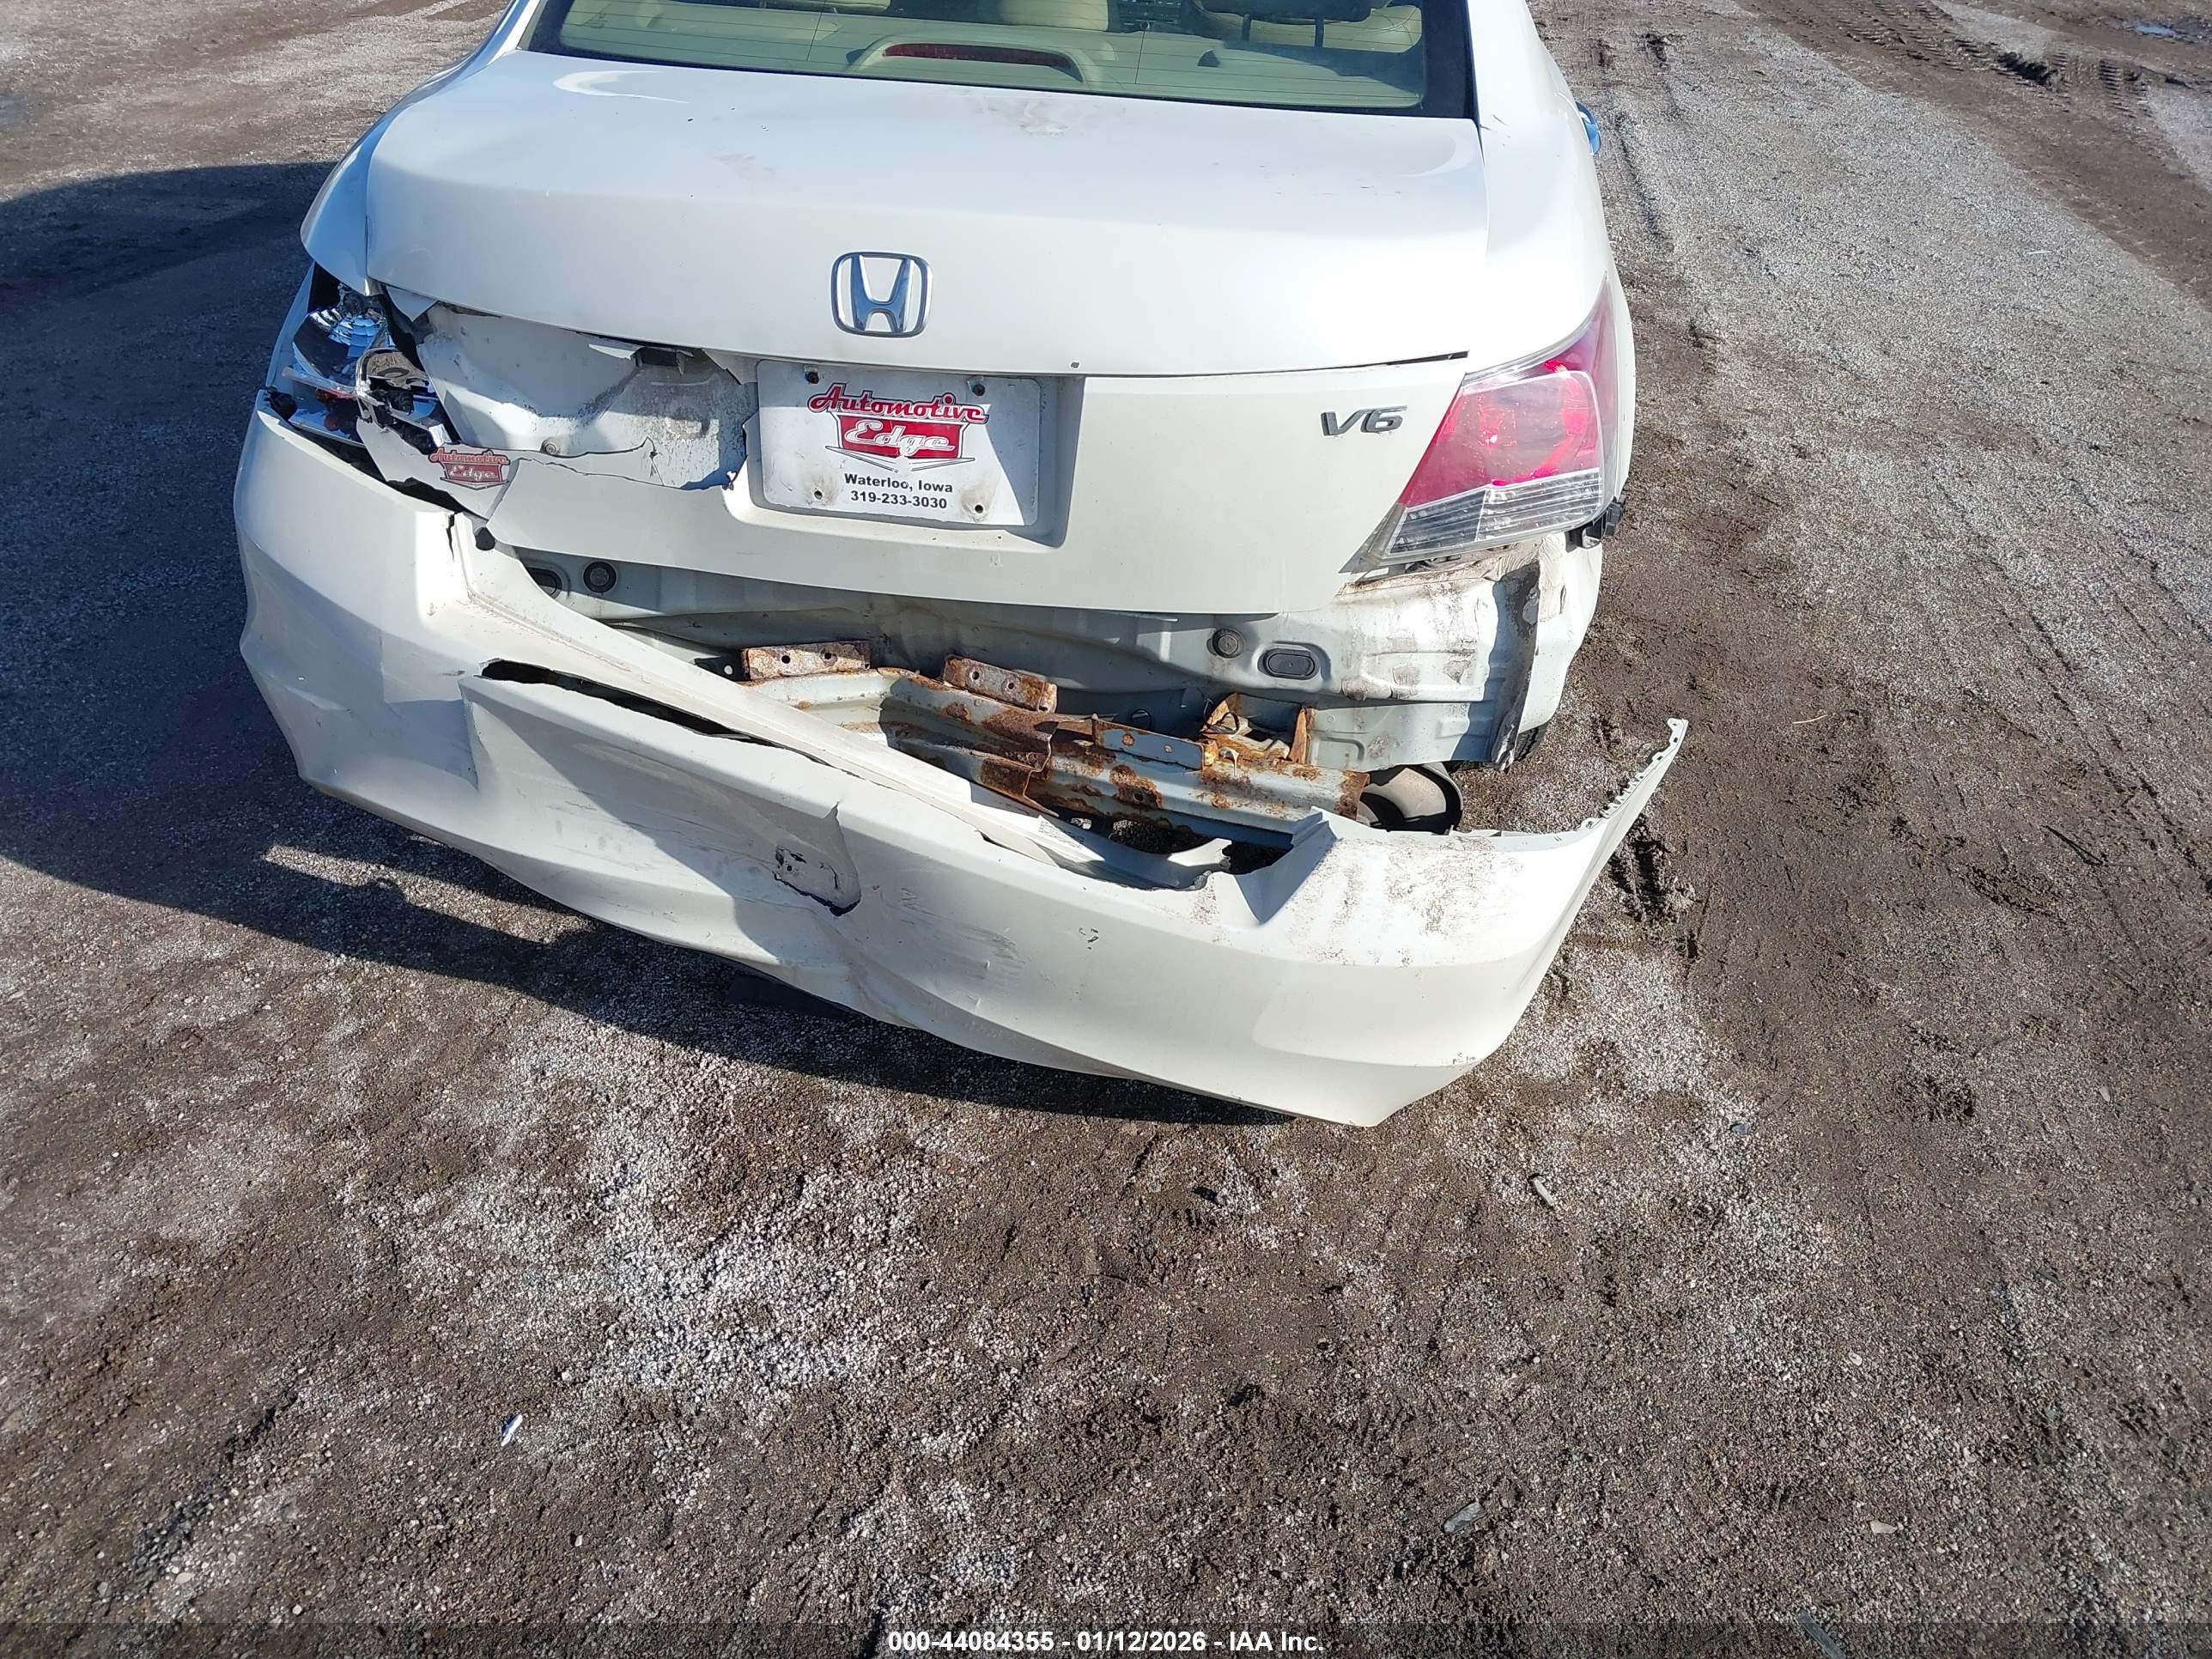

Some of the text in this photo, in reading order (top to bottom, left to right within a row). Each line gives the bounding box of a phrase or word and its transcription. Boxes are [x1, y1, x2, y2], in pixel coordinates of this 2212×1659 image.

[807, 383, 989, 424] Automotive
[1321, 405, 1407, 436] V6
[844, 420, 955, 455] Edge
[844, 473, 953, 493] Waterloo, Iowa
[850, 491, 947, 508] 319-233-3030
